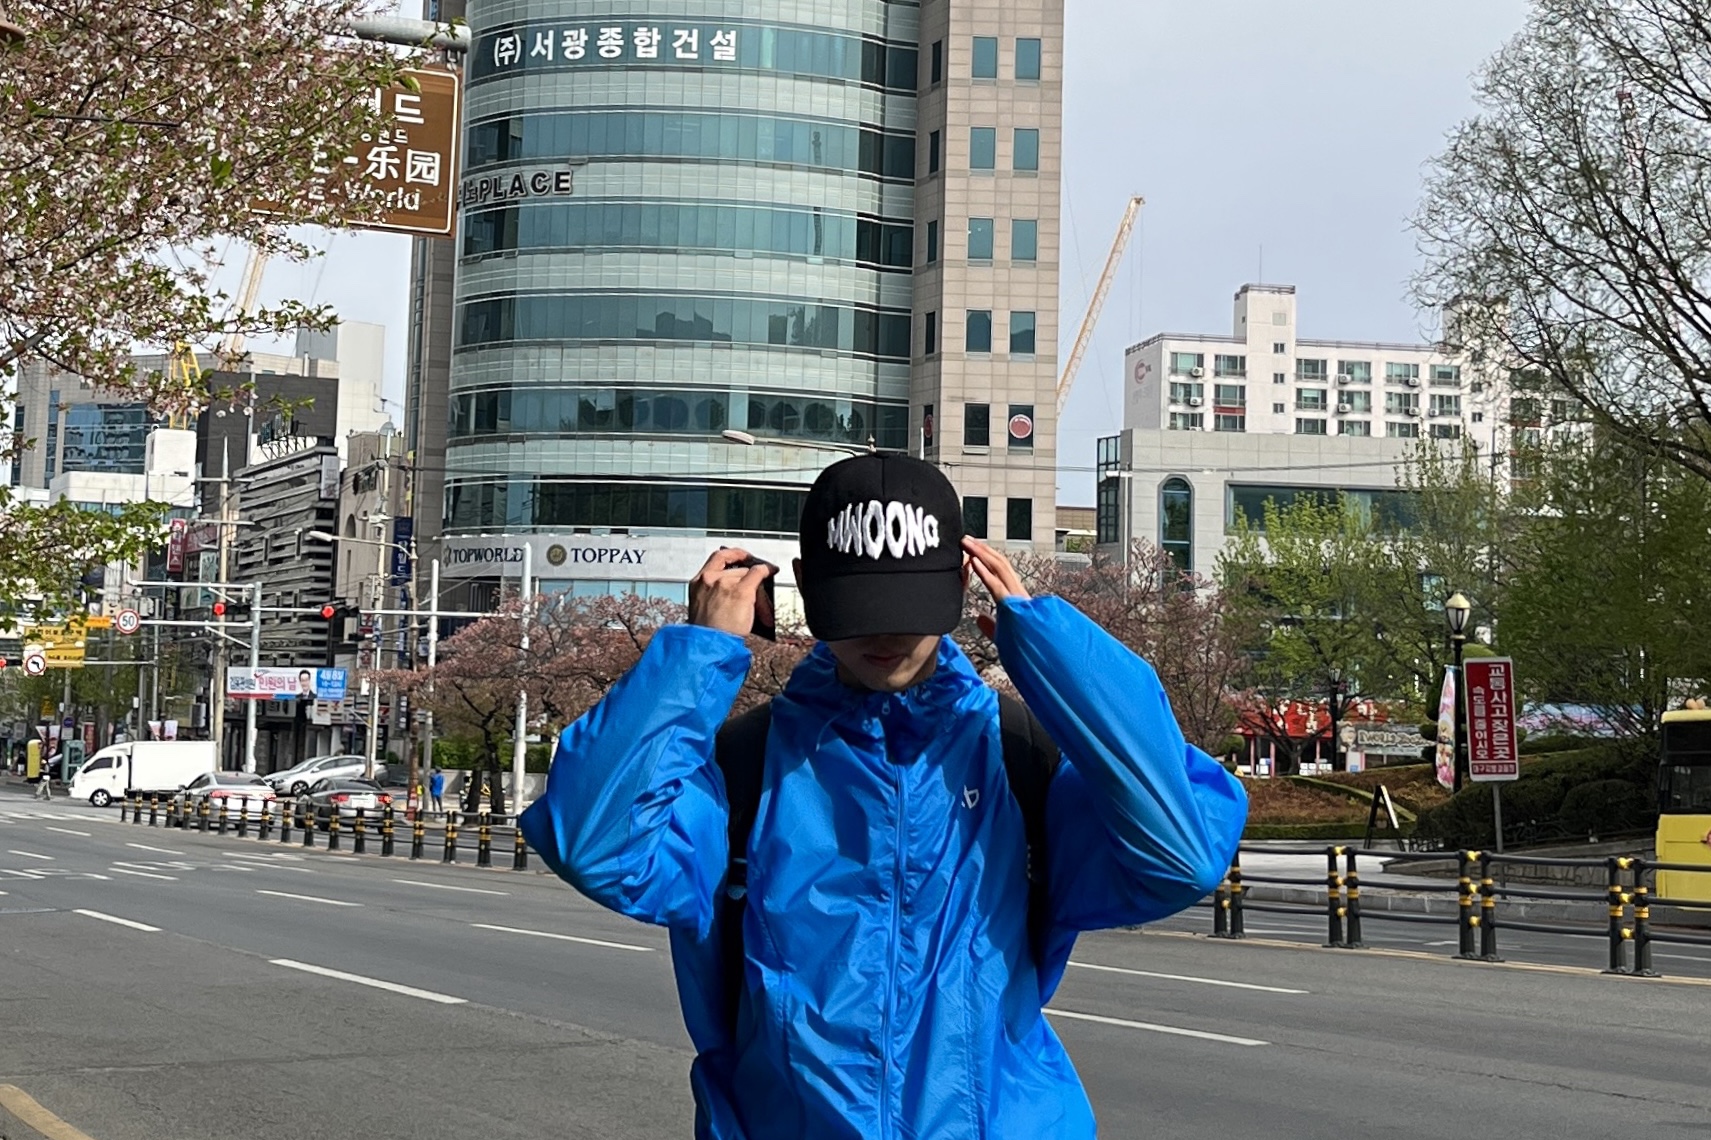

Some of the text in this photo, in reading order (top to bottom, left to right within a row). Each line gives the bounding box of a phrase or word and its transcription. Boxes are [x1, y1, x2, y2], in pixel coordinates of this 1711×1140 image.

[453, 547, 523, 564] TOPWORLD
[571, 547, 646, 564] TOPPAY
[121, 616, 136, 627] 50
